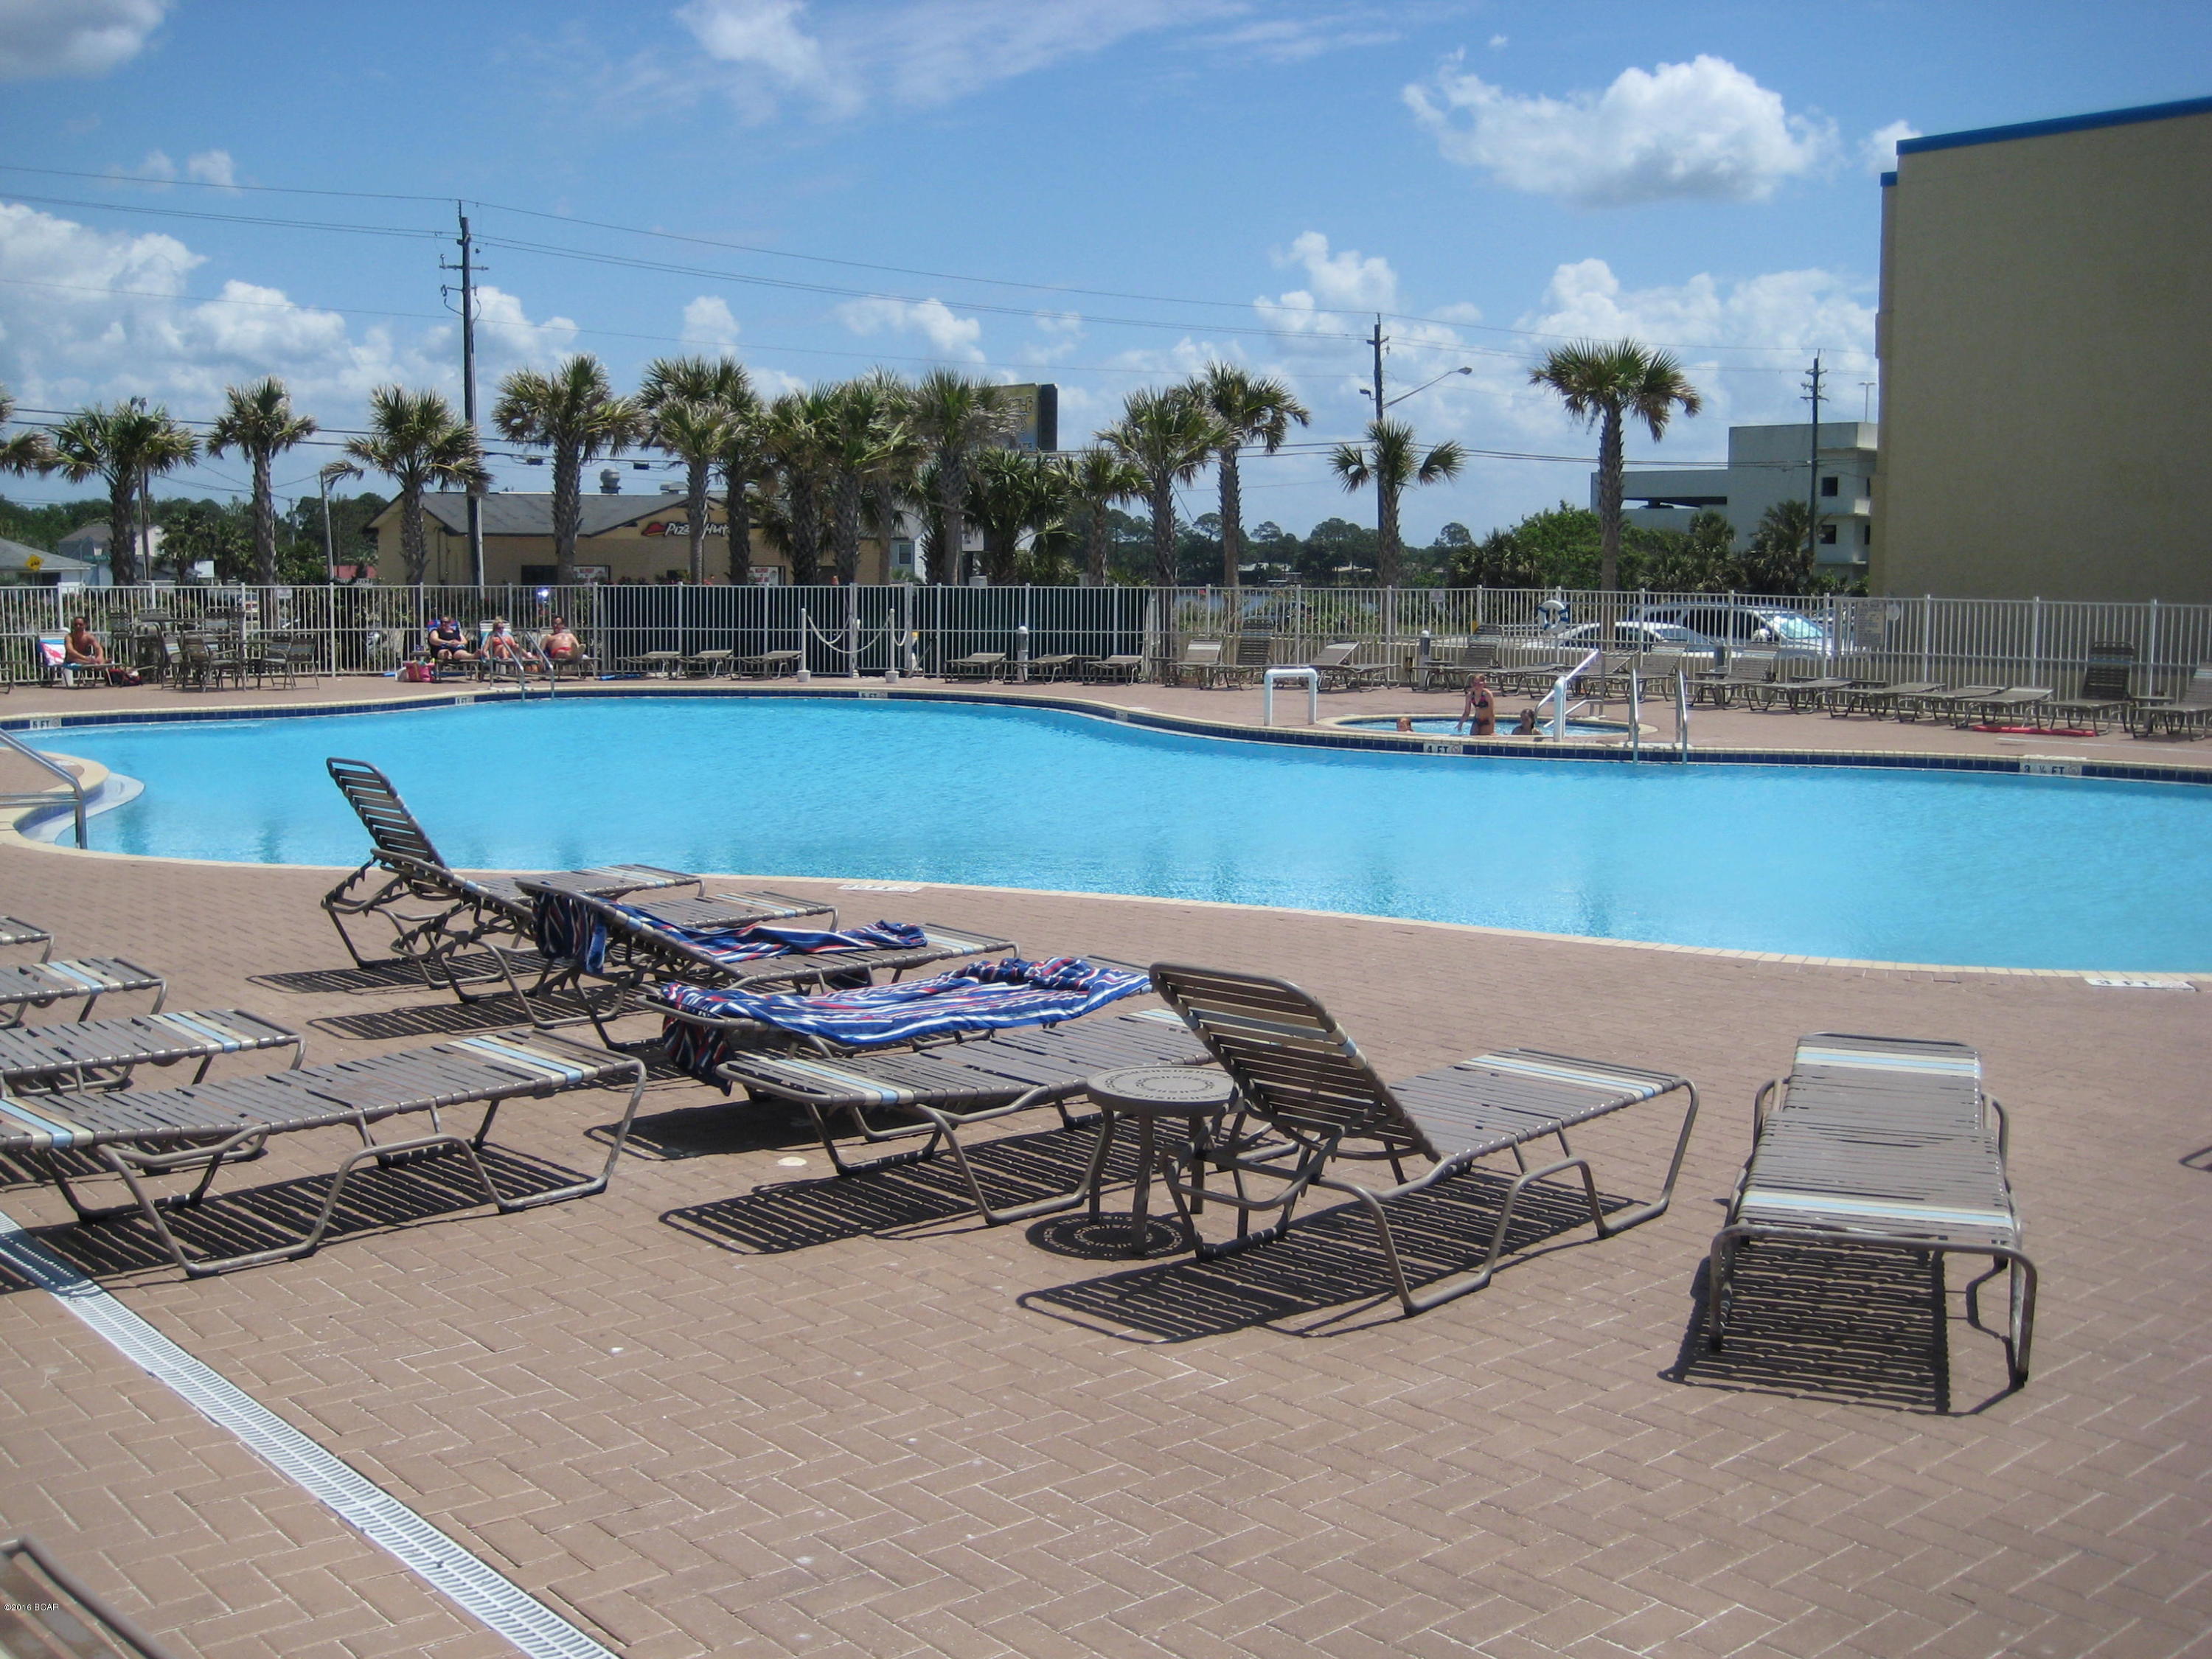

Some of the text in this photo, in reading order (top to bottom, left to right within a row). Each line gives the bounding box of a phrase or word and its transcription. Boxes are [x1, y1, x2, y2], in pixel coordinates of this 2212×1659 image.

[665, 522, 729, 536] Pizz Hut
[41, 720, 49, 728] FT
[1427, 745, 1449, 754] 4 FT
[2051, 765, 2065, 774] FT
